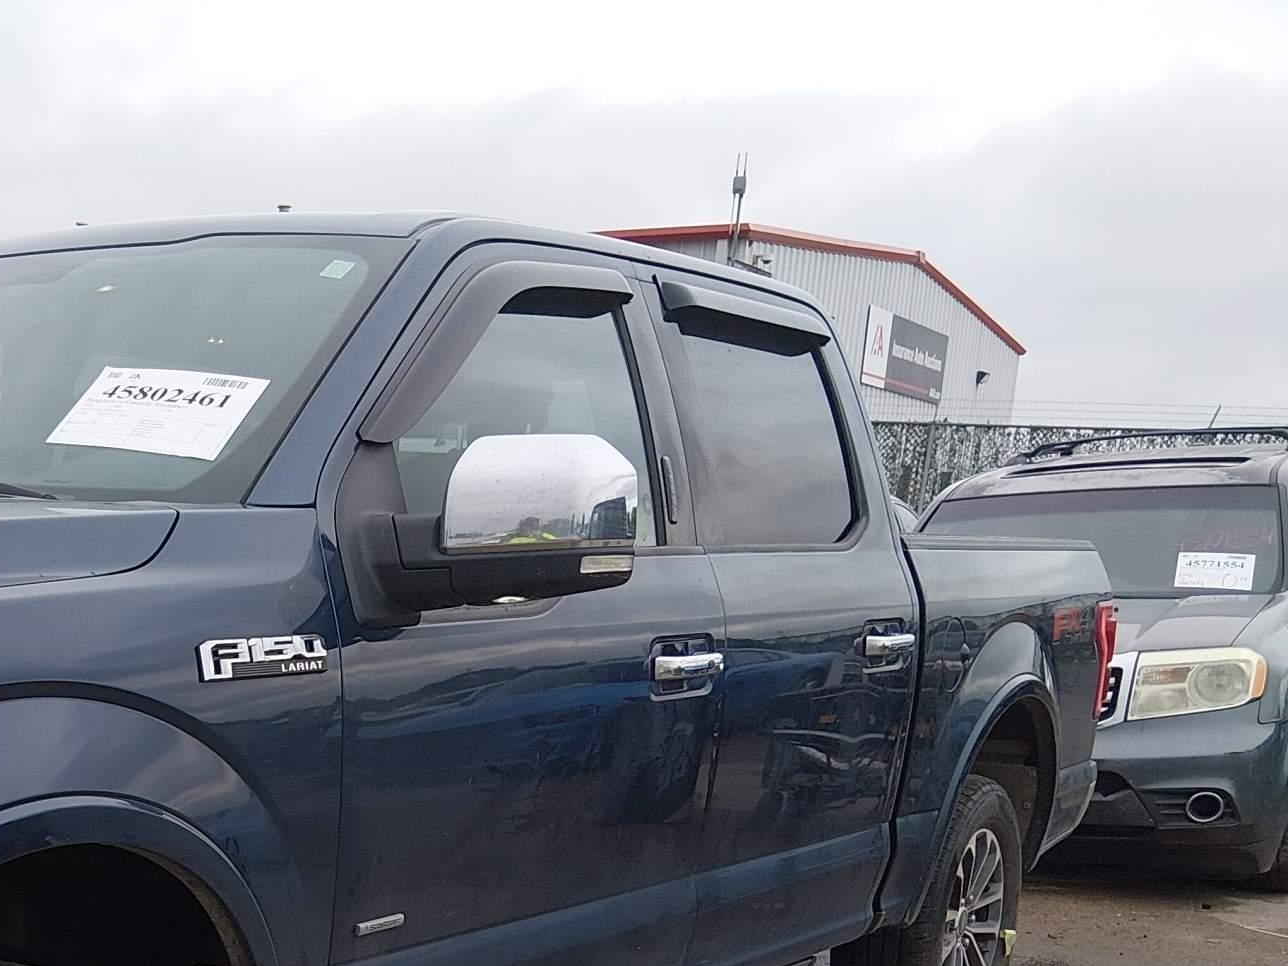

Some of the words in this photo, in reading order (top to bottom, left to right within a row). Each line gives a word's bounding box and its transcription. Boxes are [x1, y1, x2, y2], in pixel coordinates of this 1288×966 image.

[914, 346, 925, 366] Auto
[102, 384, 232, 408] 45802461
[1185, 559, 1245, 569] 45771554
[280, 660, 324, 673] LARIAT
